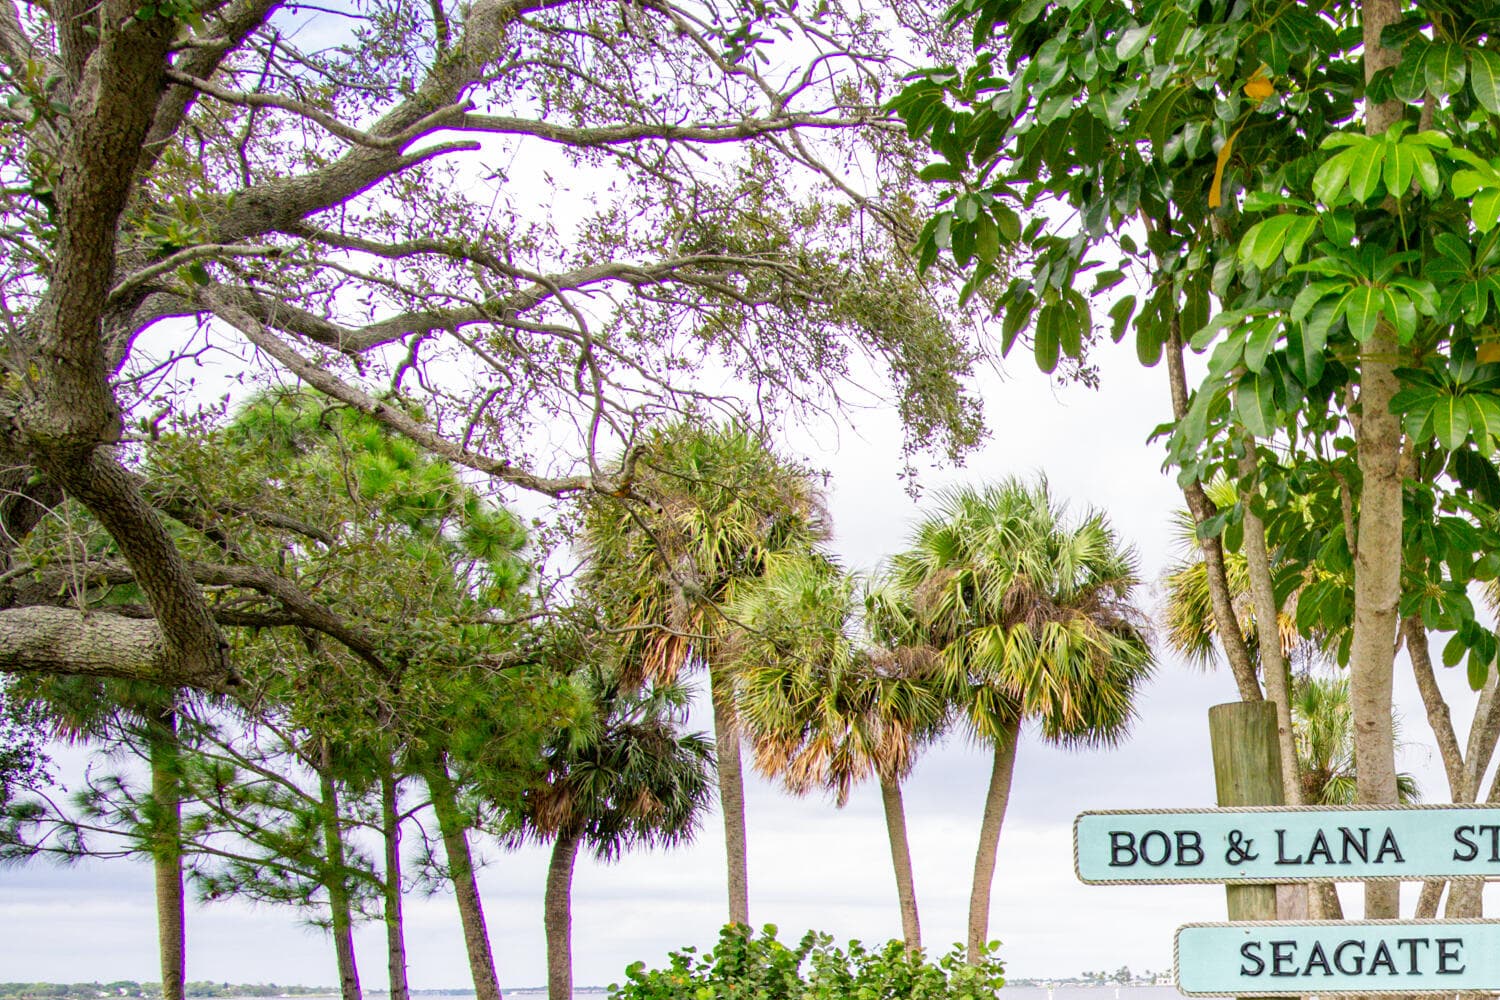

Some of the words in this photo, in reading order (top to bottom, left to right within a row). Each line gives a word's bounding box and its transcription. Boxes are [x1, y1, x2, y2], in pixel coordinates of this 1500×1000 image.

[1108, 829, 1205, 868] BOB
[1224, 829, 1260, 866] &
[1274, 826, 1406, 866] LANA
[1240, 938, 1466, 978] SEAGATE
